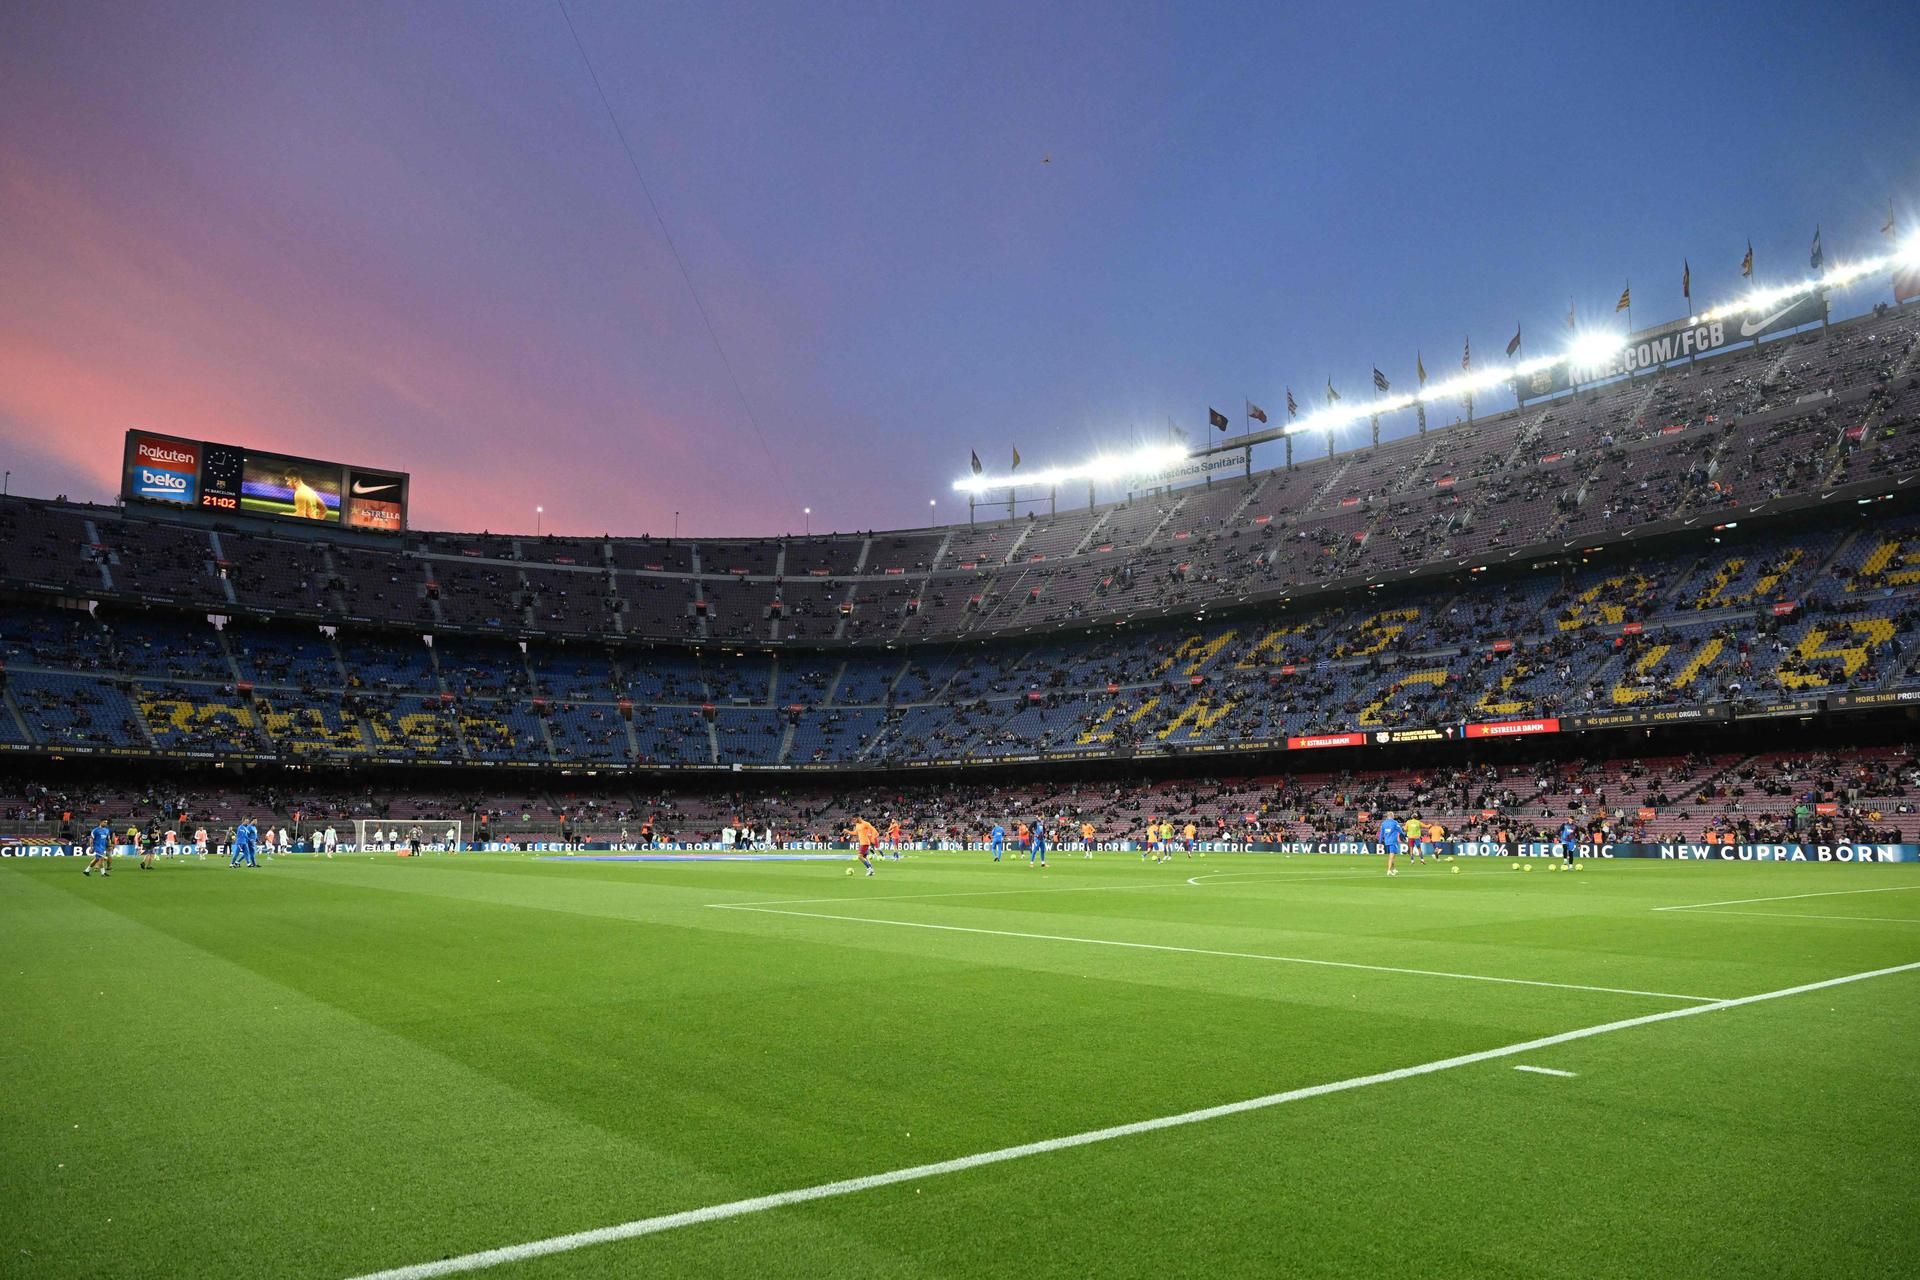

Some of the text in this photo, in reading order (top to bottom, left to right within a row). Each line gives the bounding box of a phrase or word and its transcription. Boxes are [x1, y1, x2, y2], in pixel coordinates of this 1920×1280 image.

[1568, 323, 1724, 386] NI.COM/FCB
[138, 444, 194, 464] Rakuten
[1201, 455, 1245, 472] Sanitària
[142, 470, 187, 489] beko
[203, 496, 236, 509] 21:02
[361, 509, 400, 520] ESTRELLA
[1855, 695, 1876, 704] MORE
[1877, 693, 1896, 702] THAN
[1491, 724, 1544, 734] ESTRELLA DAMM
[1333, 737, 1350, 745] DAMM
[1, 846, 123, 857] CUPRA BON
[484, 843, 585, 852] 100% ELECTRIC
[687, 843, 719, 851] BORN
[783, 842, 833, 850] ELECTRIC
[938, 842, 1011, 850] 100% ELECIC
[1057, 843, 1090, 851] CUPR
[1282, 843, 1312, 853] NEW
[1318, 843, 1370, 854] CUPRA
[1457, 844, 1614, 858] 100% ELECRIC
[1661, 845, 1894, 862] NEW CUPRA BORN
